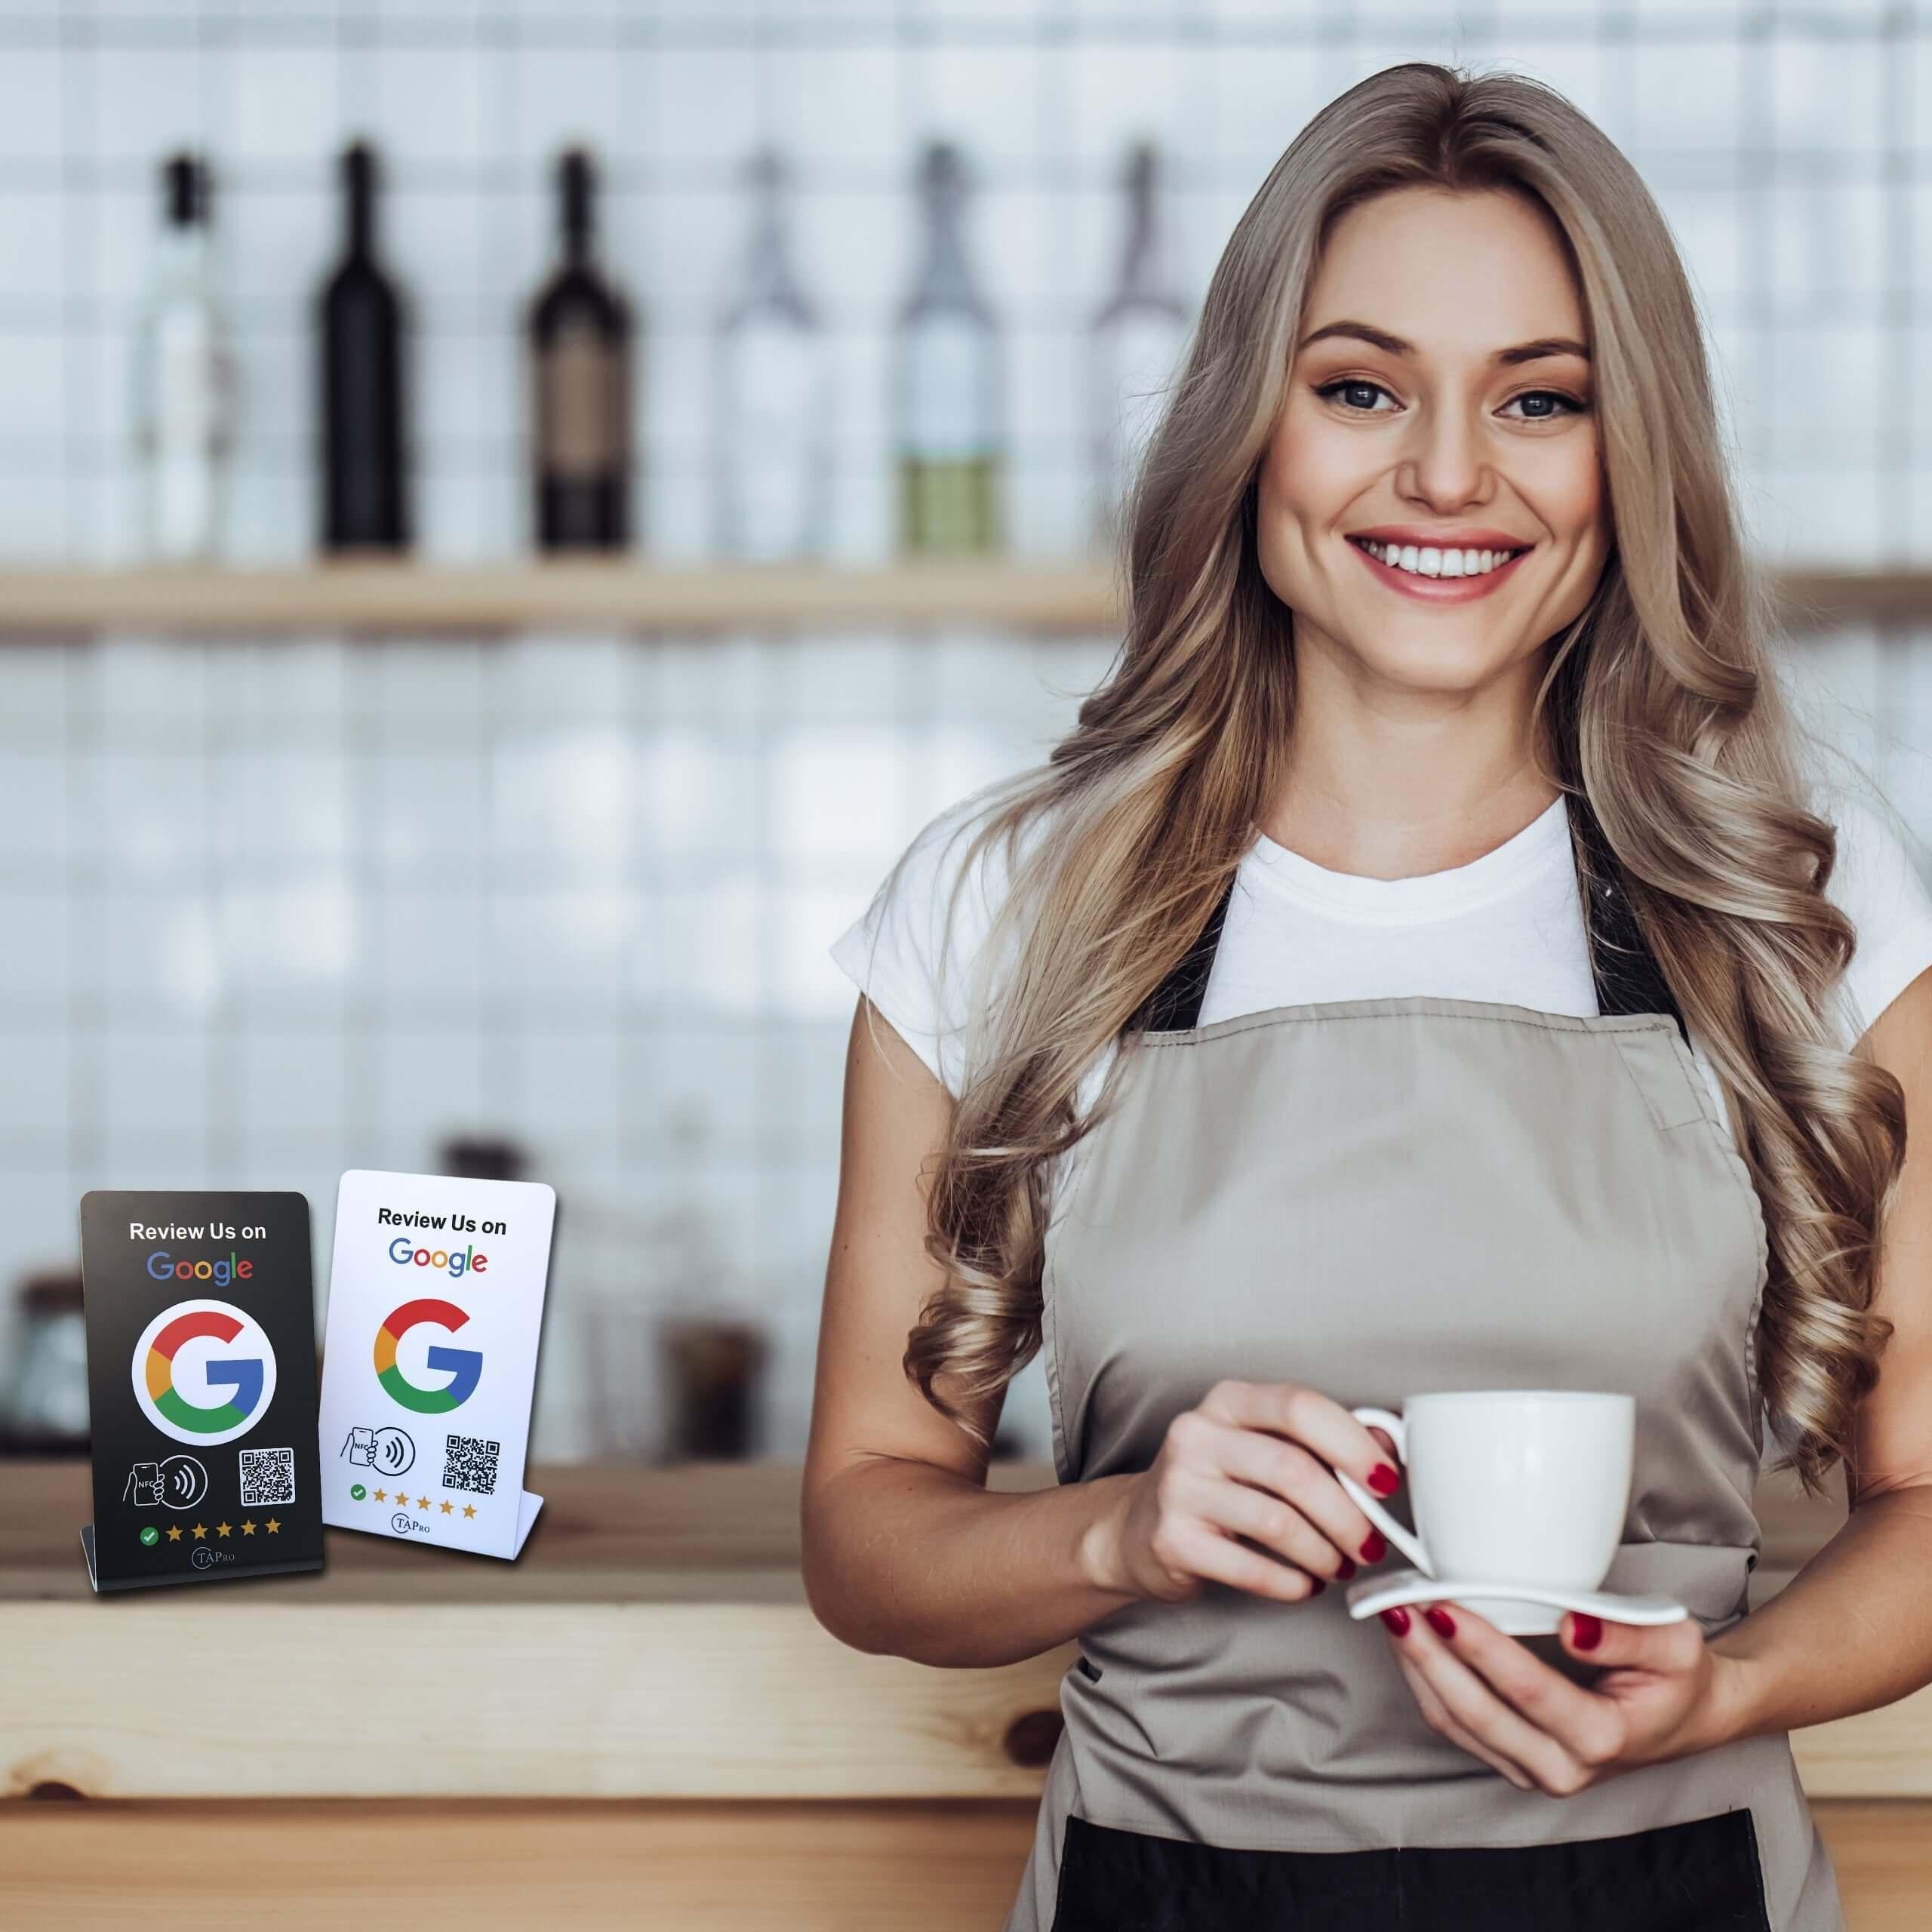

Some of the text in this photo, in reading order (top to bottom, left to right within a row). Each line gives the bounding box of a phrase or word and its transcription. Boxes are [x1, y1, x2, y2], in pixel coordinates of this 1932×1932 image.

[130, 1222, 266, 1240] Review Us on
[378, 1208, 506, 1235] Review Us on
[146, 1251, 254, 1287] Google
[389, 1237, 488, 1278] Google
[145, 1311, 264, 1433] G
[374, 1298, 483, 1414] G
[355, 1442, 369, 1451] NFC
